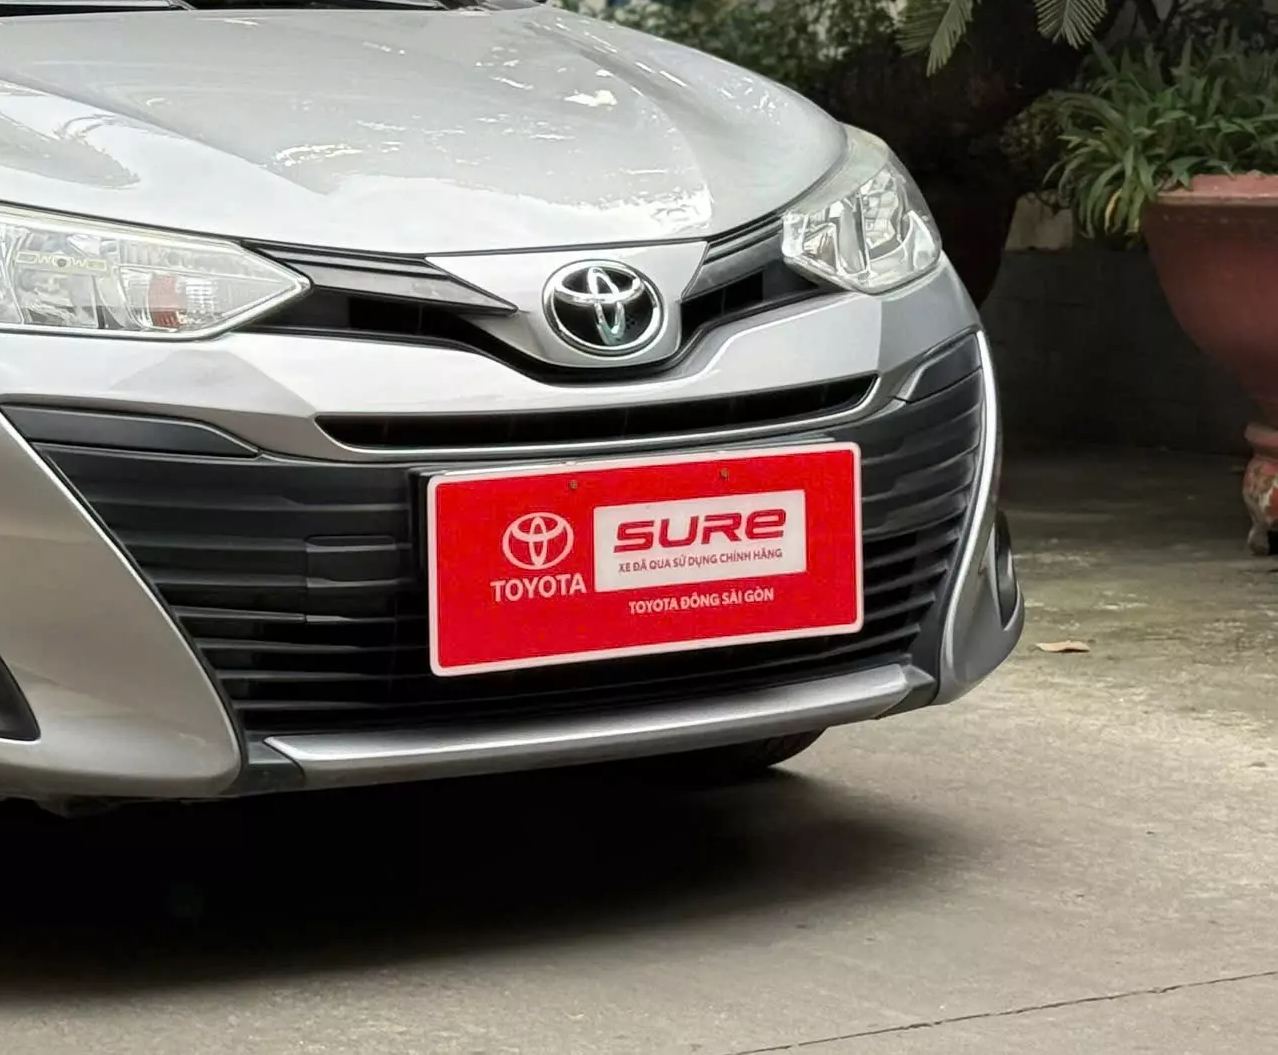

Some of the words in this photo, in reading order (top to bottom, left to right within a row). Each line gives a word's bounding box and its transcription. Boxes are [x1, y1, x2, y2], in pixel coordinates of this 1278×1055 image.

[618, 562, 631, 573] XE
[633, 558, 648, 572] ĐÃ
[649, 559, 672, 571] QUA
[673, 554, 687, 569] SỬ
[688, 554, 718, 570] DỤNG
[719, 549, 752, 564] CHÍNH
[753, 547, 784, 561] HÃNG
[490, 573, 587, 602] TOYOTA
[628, 597, 679, 614] TOYOTA
[680, 592, 720, 610] ĐÔNG
[721, 588, 742, 606] SÀI
[744, 586, 775, 602] GÒN
